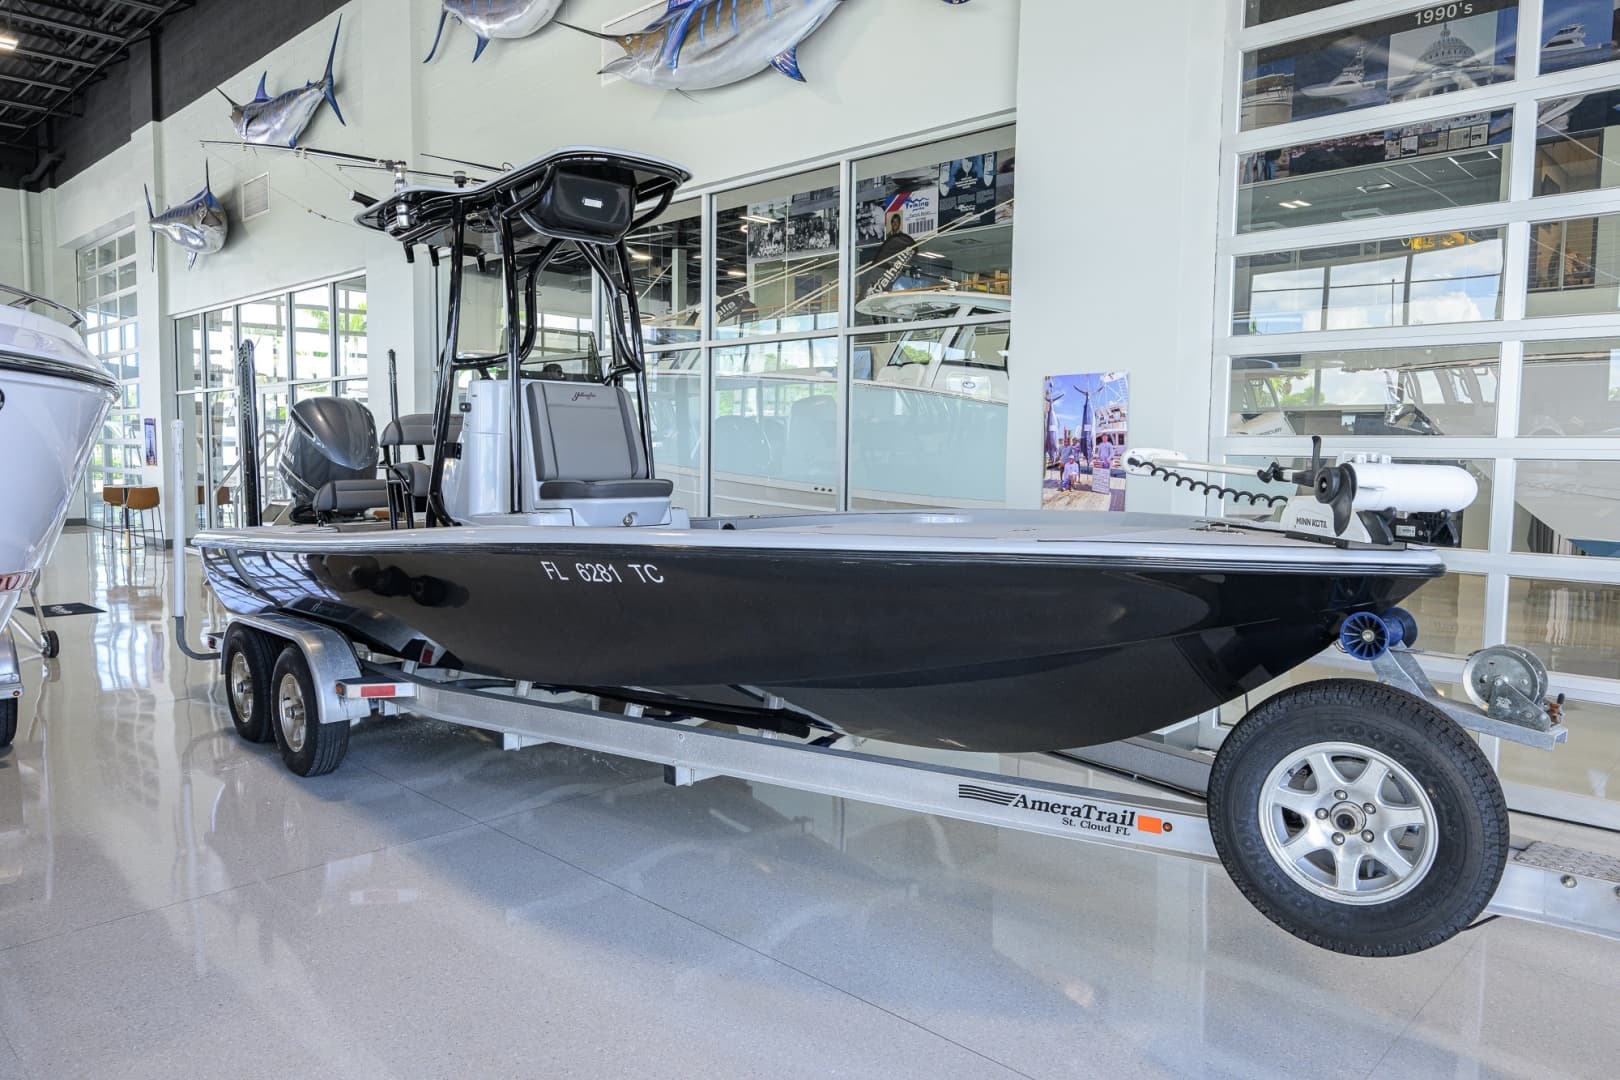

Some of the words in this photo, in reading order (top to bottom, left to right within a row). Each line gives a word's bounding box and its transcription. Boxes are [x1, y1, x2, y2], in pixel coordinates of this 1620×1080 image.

[1415, 2, 1472, 25] 1990's
[540, 561, 569, 580] FL
[576, 563, 622, 583] 6281
[627, 564, 665, 584] TC
[1013, 794, 1136, 827] AmeraTrail
[1062, 817, 1076, 827] St.
[1080, 821, 1111, 833] Cloud
[1115, 826, 1131, 836] FL
